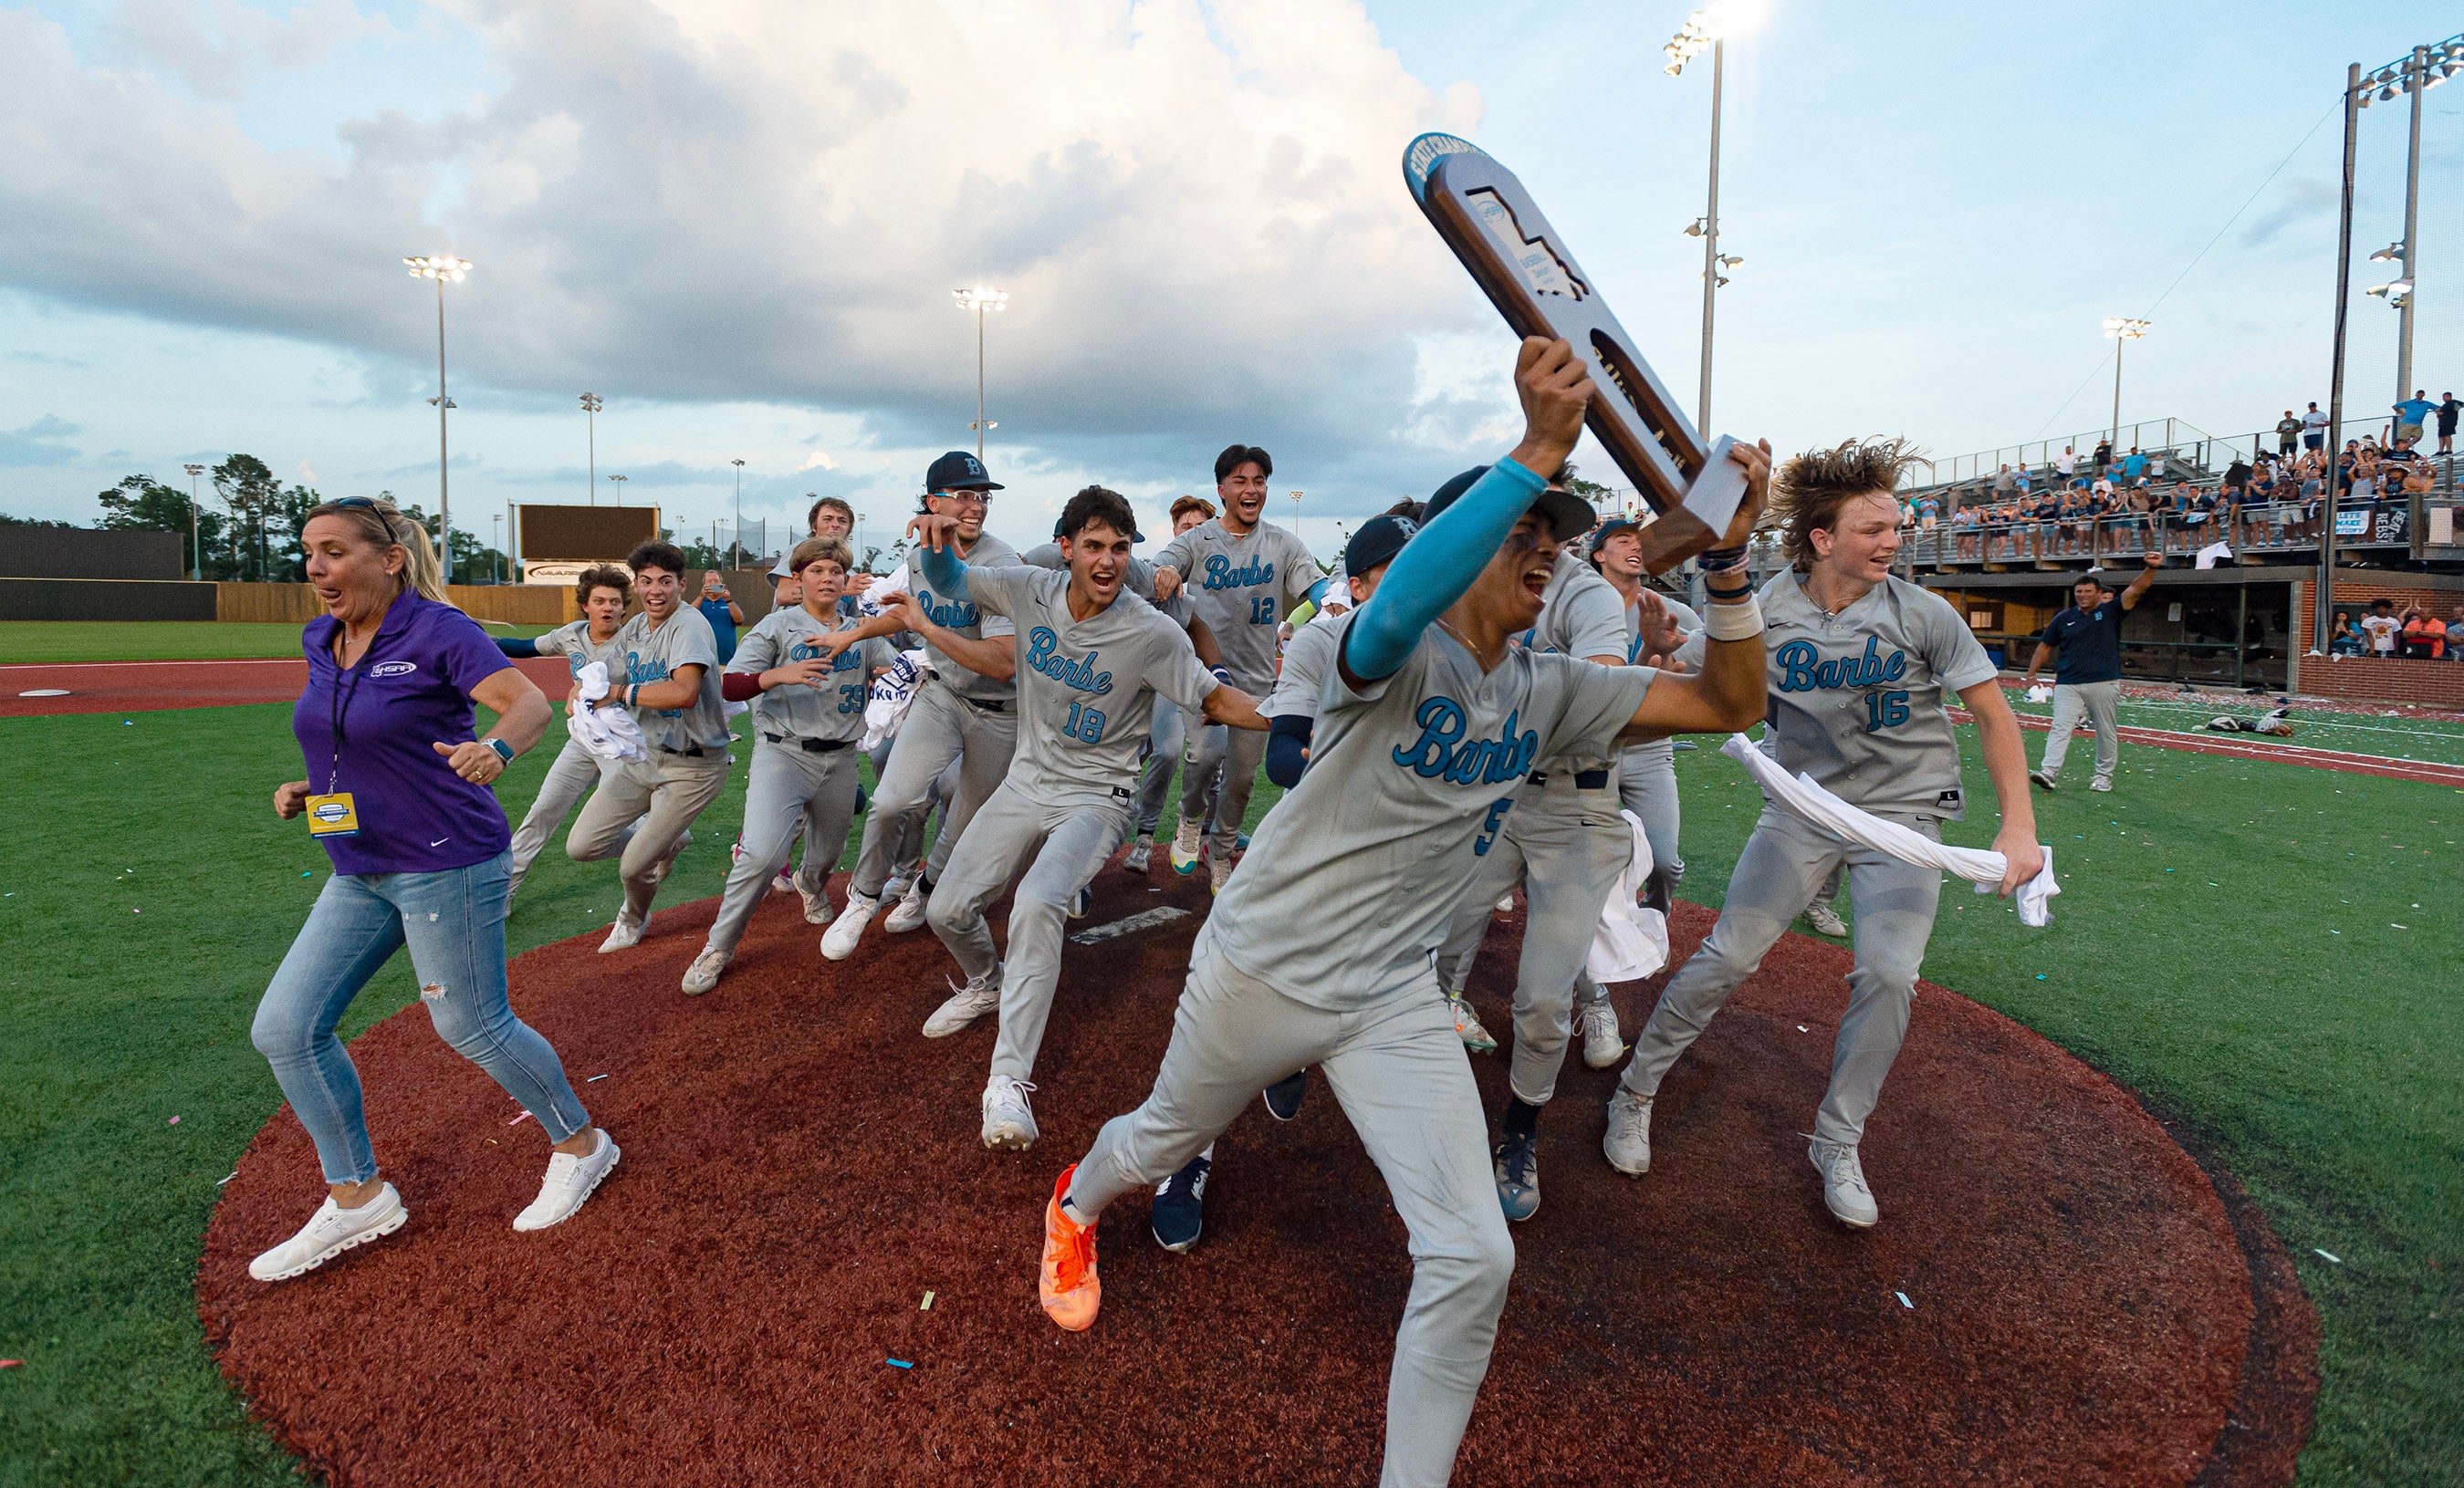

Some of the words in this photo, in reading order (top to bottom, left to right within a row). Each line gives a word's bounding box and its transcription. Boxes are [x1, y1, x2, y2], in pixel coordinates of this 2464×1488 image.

[1410, 138, 1438, 182] STATE
[965, 457, 981, 475] B
[2390, 511, 2407, 534] BEAT
[1203, 554, 1274, 590] Barbe
[1249, 598, 1275, 624] 12
[1026, 626, 1112, 695] Barbe
[1776, 635, 1906, 692] Barbe
[838, 684, 865, 713] 39
[1864, 690, 1910, 732] 16
[1062, 702, 1106, 744] 18
[1393, 696, 1538, 786] Barbe
[1474, 797, 1514, 856] 5
